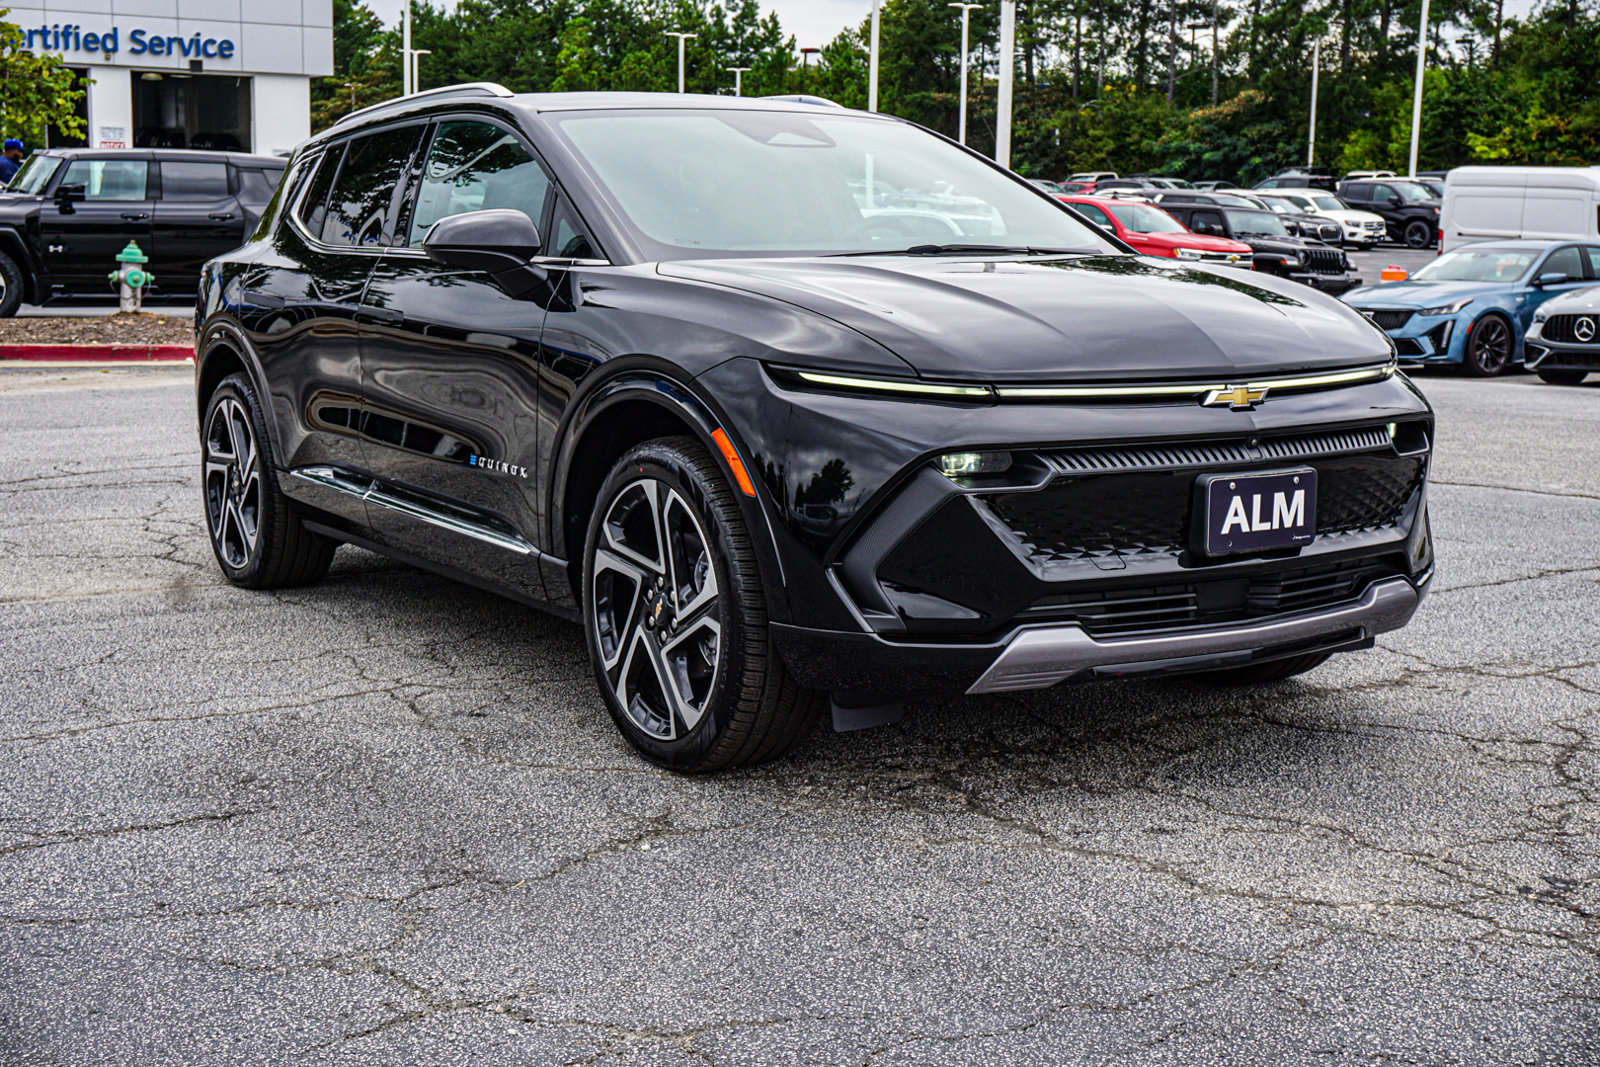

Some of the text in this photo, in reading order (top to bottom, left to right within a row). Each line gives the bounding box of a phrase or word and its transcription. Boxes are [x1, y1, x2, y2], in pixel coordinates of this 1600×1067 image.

[129, 29, 235, 58] Service
[469, 454, 528, 478] EQUINOX
[1220, 489, 1305, 535] ALM
